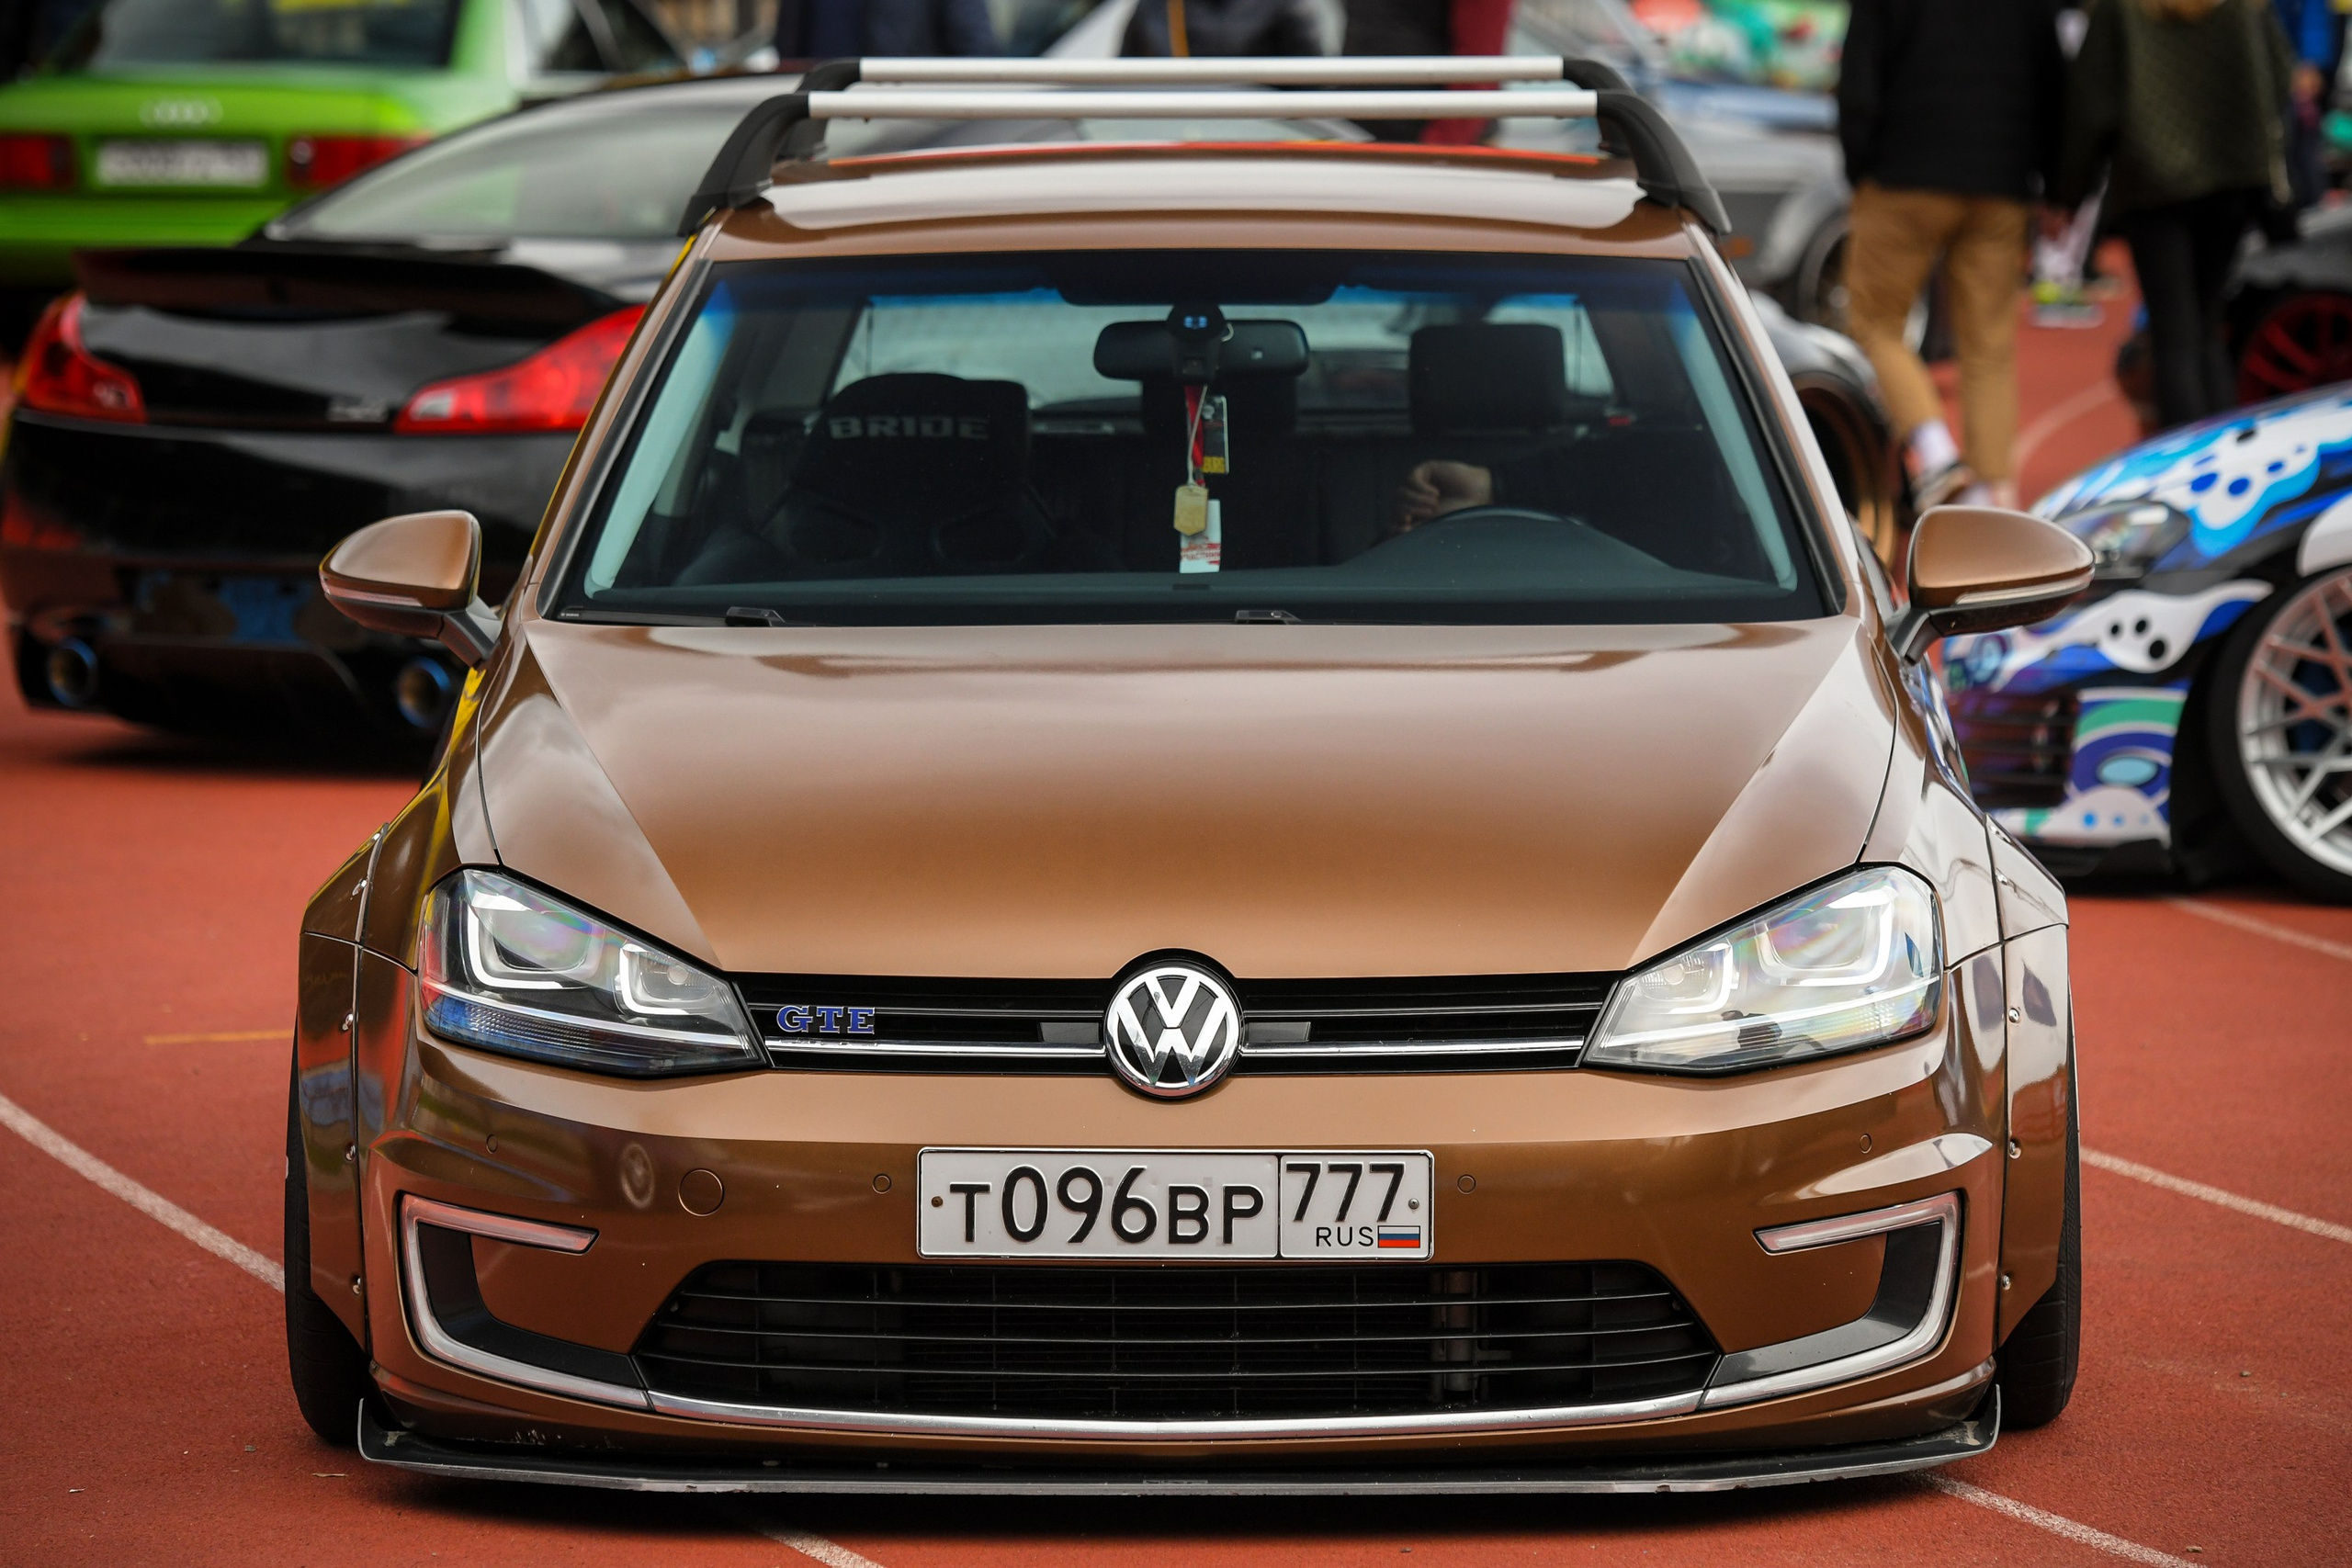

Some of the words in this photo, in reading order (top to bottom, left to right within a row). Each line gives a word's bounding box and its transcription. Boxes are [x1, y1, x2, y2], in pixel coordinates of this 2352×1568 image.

[829, 416, 990, 439] BRIDE
[776, 1005, 876, 1034] GTE
[1115, 970, 1231, 1085] VW
[1285, 1162, 1406, 1223] 777
[1316, 1226, 1374, 1247] RUS
